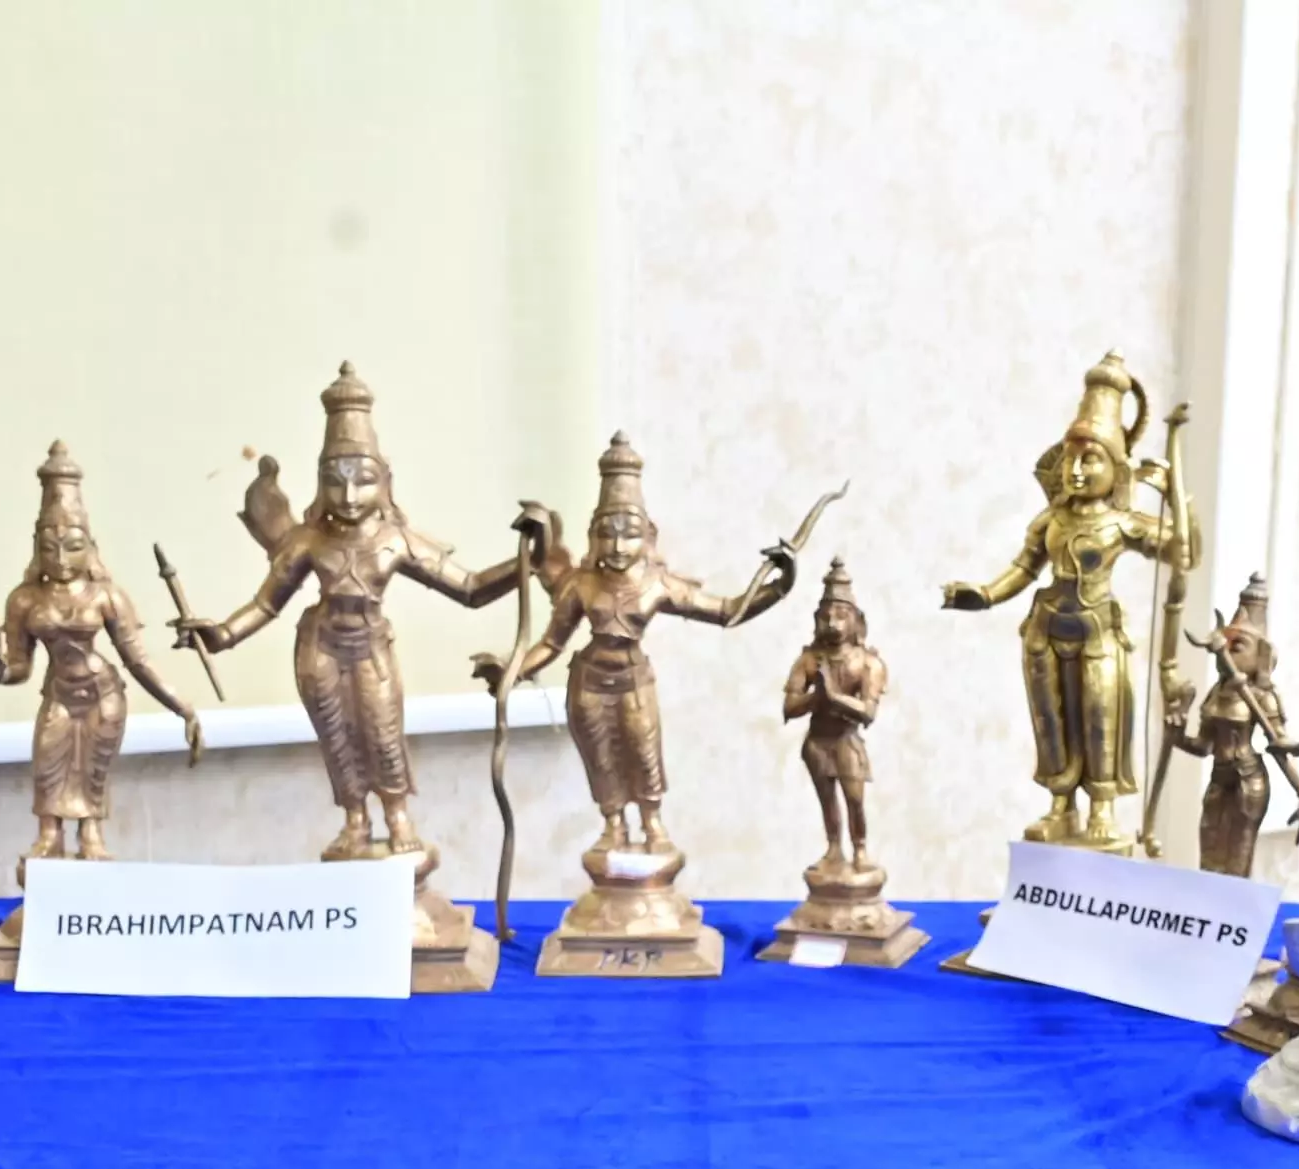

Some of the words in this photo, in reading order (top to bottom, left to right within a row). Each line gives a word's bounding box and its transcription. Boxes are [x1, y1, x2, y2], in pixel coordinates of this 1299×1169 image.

[56, 908, 314, 936] IBRAHIMPATNAM
[325, 907, 358, 930] PS
[1013, 883, 1211, 938] ABDULLAPURMET
[1216, 924, 1249, 947] PS
